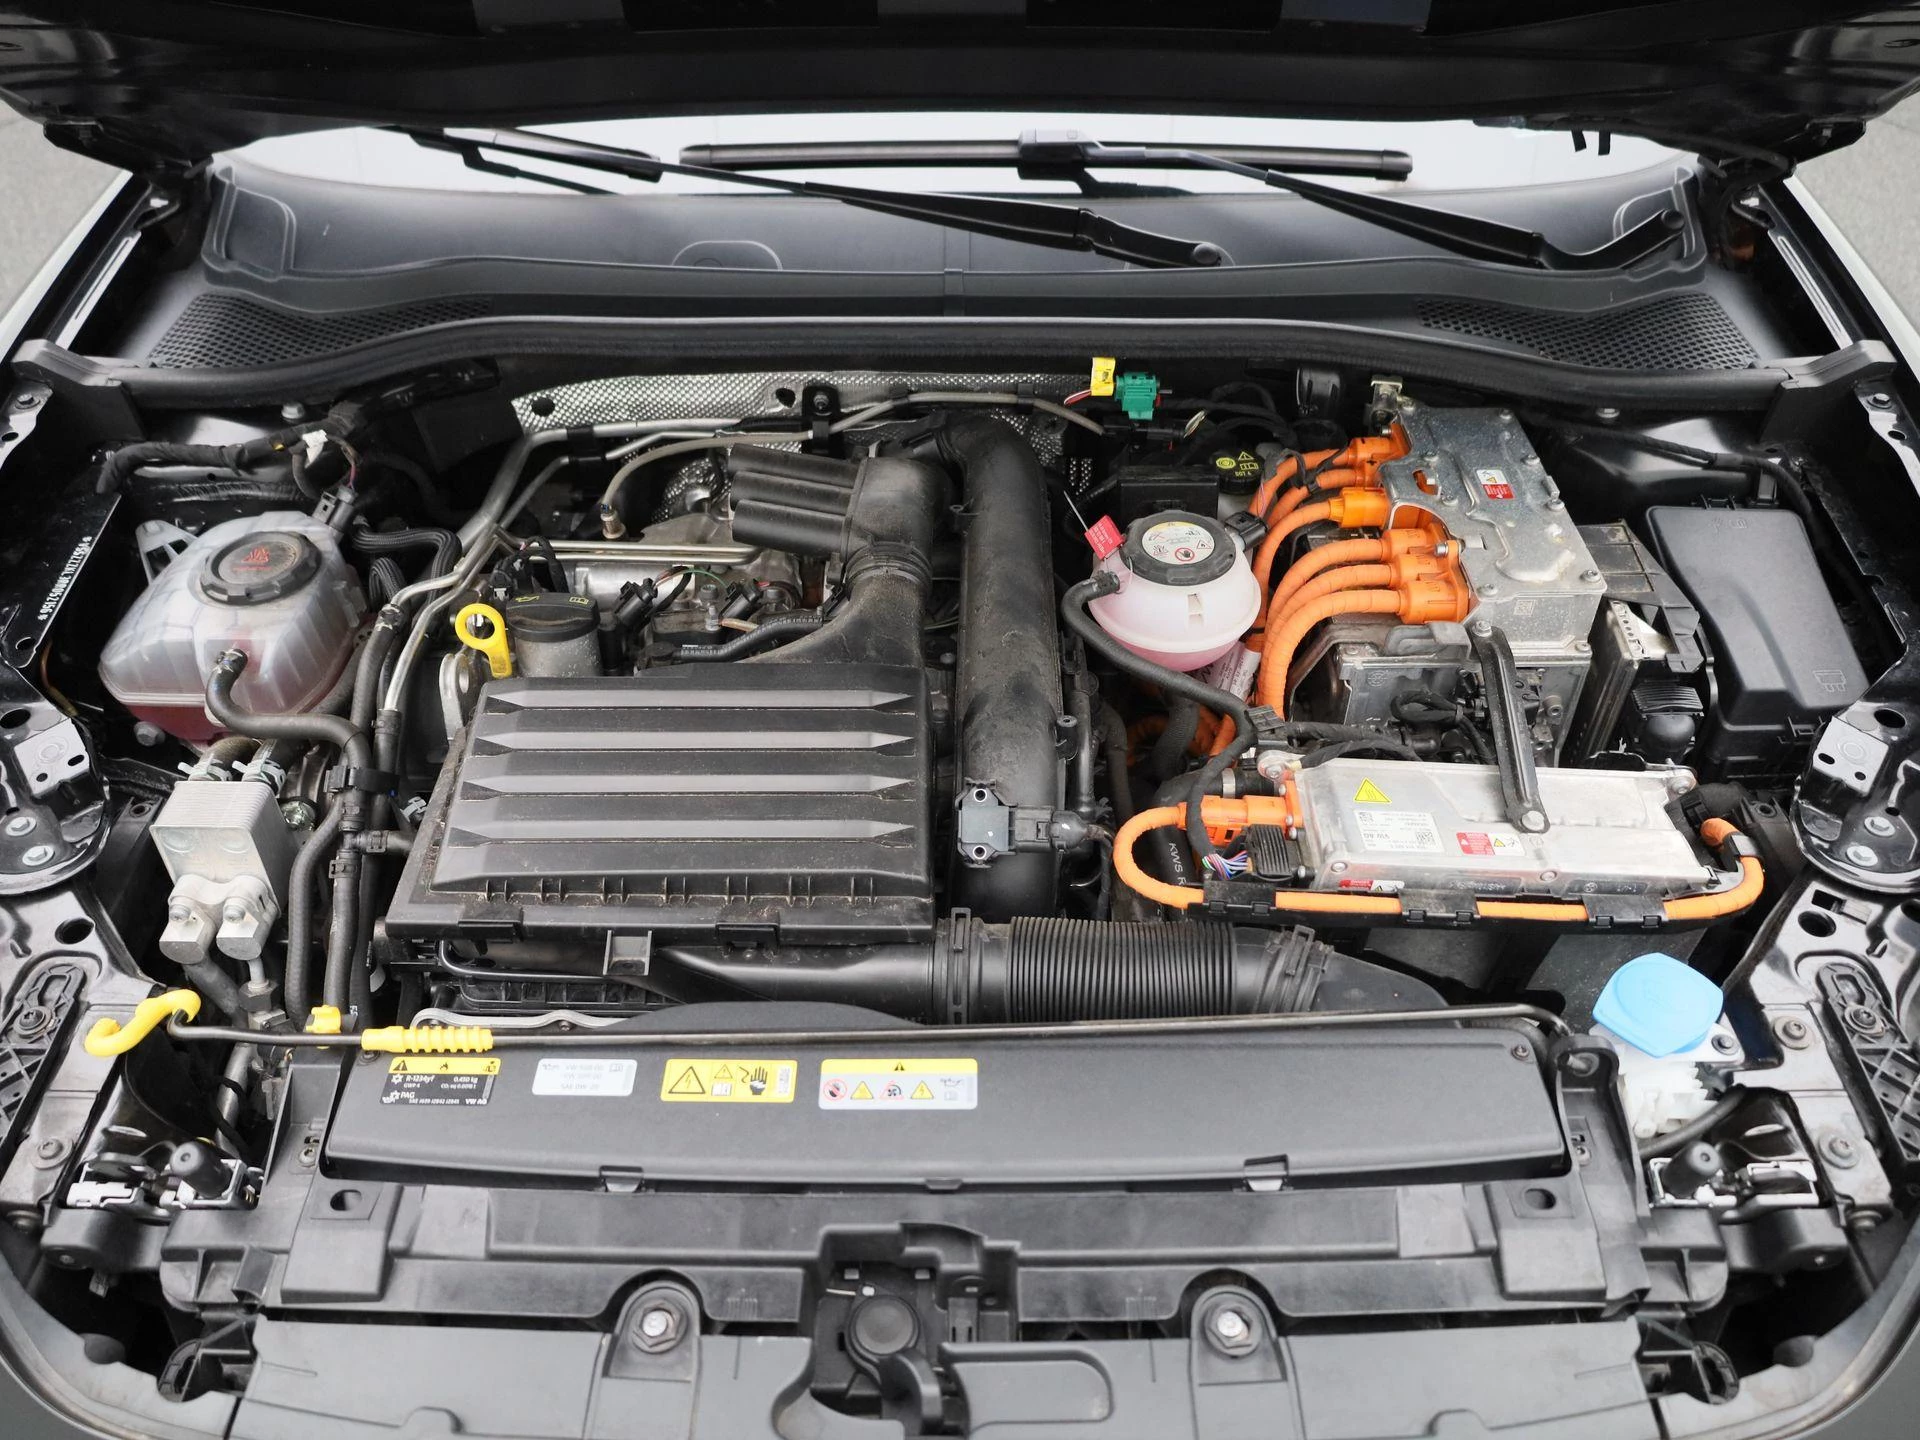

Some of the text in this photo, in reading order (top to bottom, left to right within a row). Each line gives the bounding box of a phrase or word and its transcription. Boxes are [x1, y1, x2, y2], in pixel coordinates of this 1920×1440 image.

[1169, 842, 1184, 873] KWS
[405, 1074, 435, 1084] R-1234yf
[400, 1091, 415, 1099] PAG
